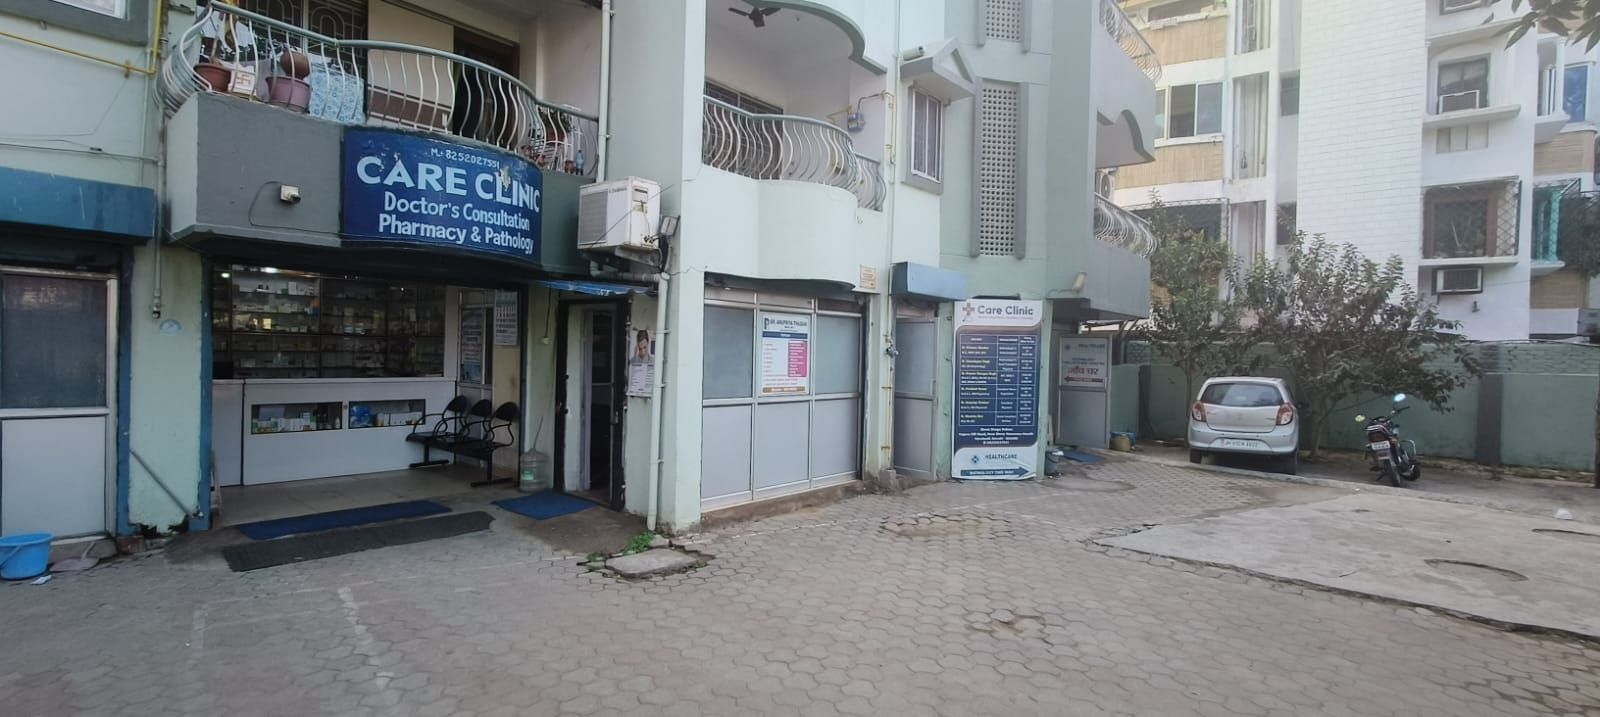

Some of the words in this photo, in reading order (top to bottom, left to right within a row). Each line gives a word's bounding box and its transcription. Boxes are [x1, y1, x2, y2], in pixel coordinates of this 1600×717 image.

[356, 156, 468, 197] CARE
[474, 171, 541, 214] CLINIC
[384, 191, 460, 219] Doctor's
[462, 203, 531, 232] Consultation
[378, 213, 467, 245] Pharmacy
[470, 226, 482, 243] &
[484, 226, 535, 255] Pathology
[977, 304, 1003, 315] Care
[1005, 305, 1034, 316] Clinic
